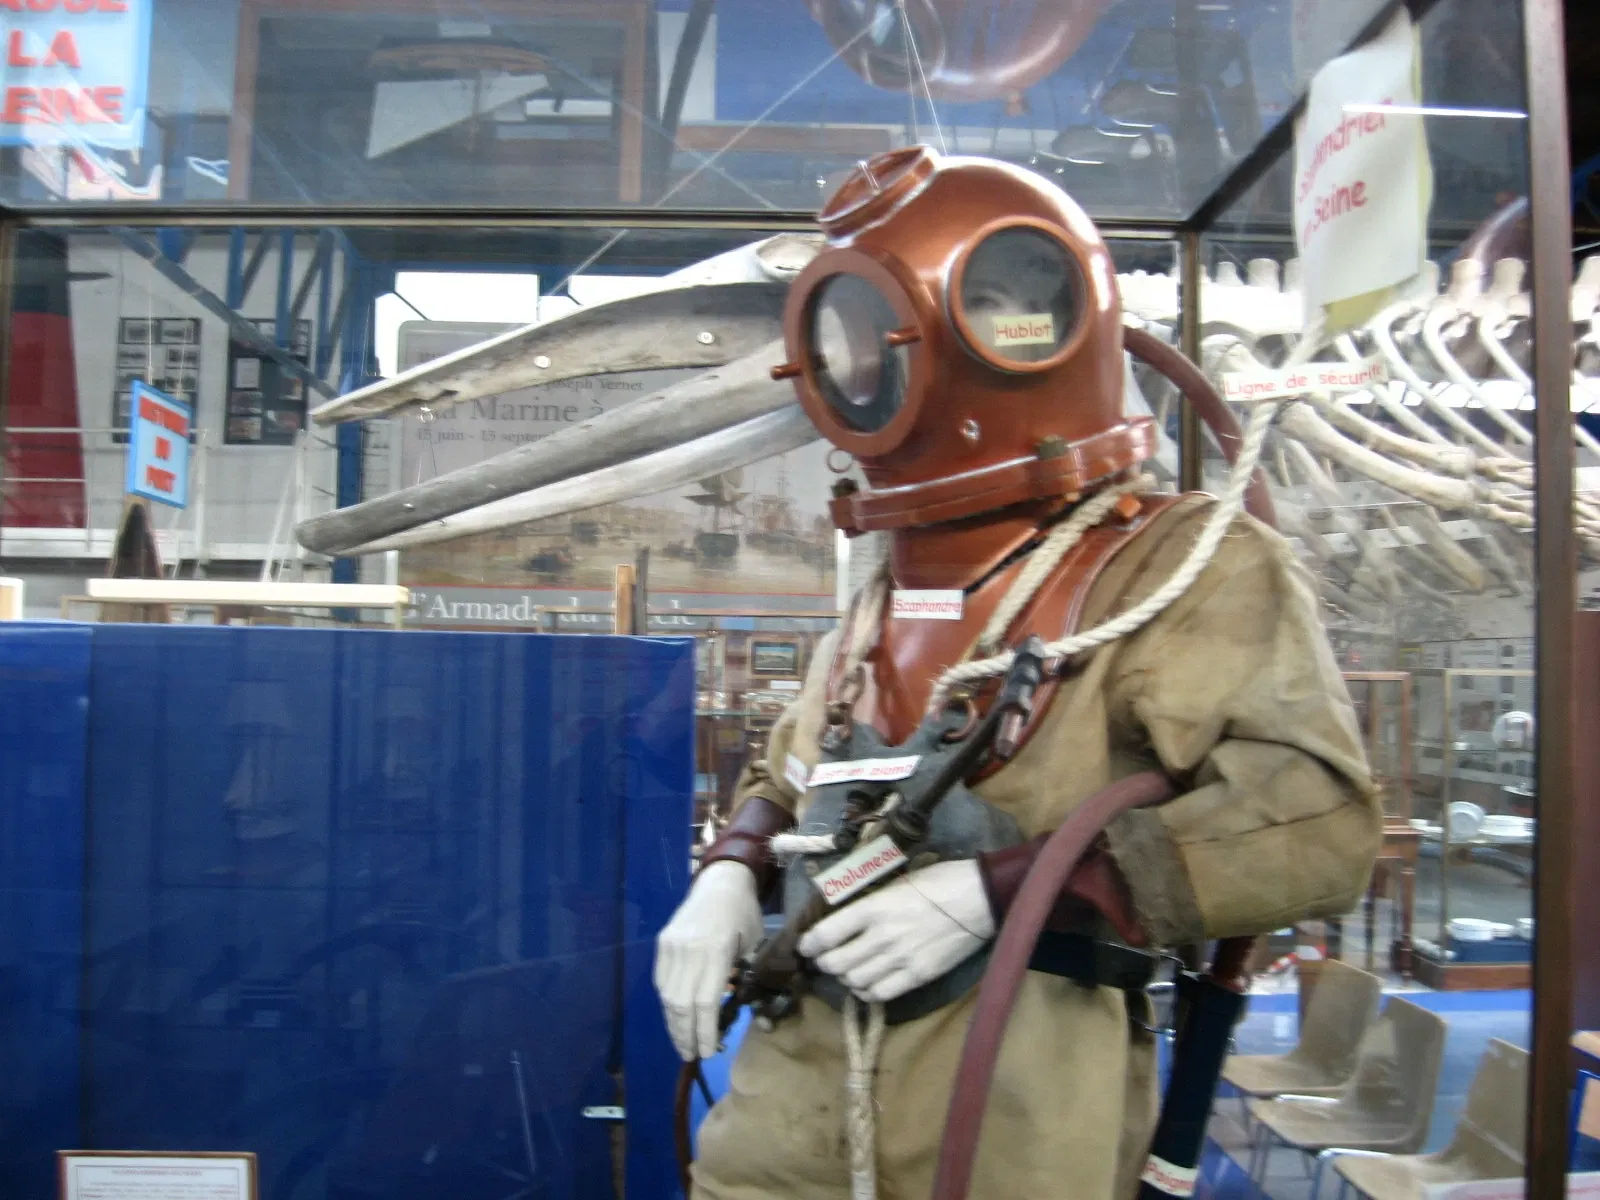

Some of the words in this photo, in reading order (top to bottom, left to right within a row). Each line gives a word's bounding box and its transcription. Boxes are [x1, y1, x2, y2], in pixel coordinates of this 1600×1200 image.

[7, 29, 81, 68] LA
[0, 86, 125, 124] EINE
[995, 322, 1052, 339] Hublot
[1226, 378, 1277, 400] Ligne
[1286, 374, 1308, 389] de
[470, 396, 579, 422] Marine
[822, 848, 902, 898] Chalumeau
